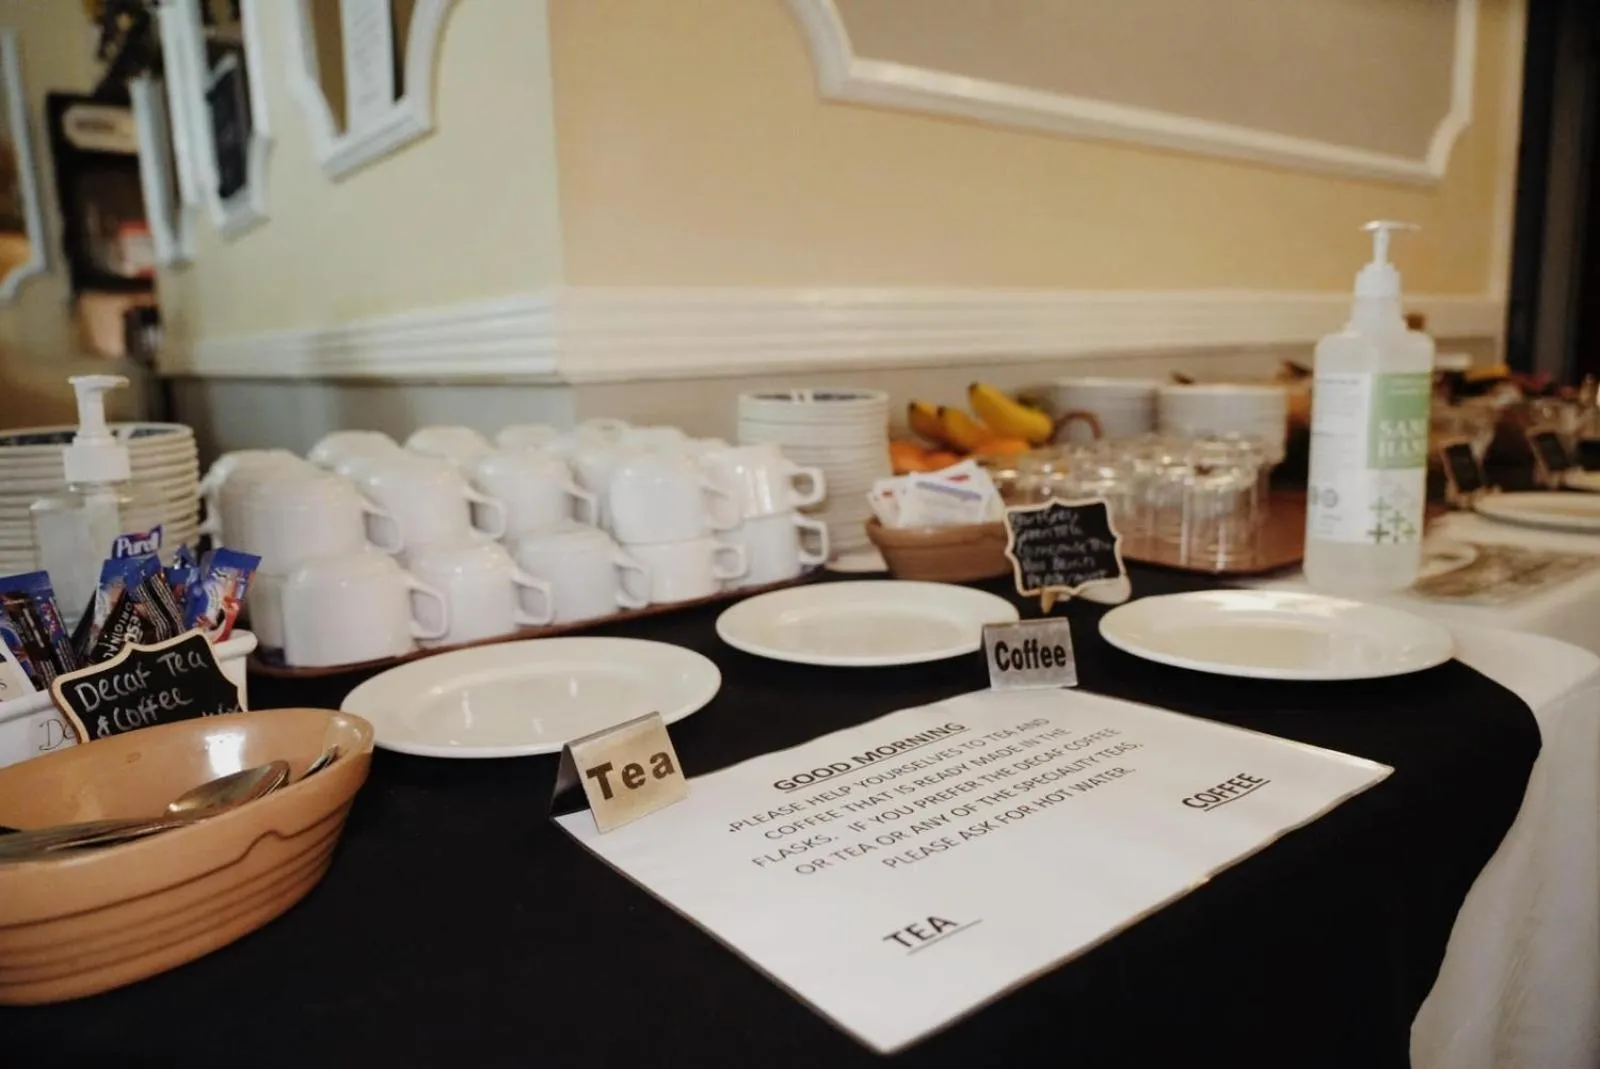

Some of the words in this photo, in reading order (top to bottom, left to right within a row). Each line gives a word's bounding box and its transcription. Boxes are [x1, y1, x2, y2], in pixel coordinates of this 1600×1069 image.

[74, 663, 151, 712] Decaf
[156, 650, 208, 678] Tea
[994, 639, 1066, 671] Coffee
[113, 686, 194, 732] Coffee
[585, 751, 676, 801] Tea
[764, 809, 844, 840] COFFEE
[840, 791, 894, 813] THAT
[893, 784, 916, 796] IS
[915, 763, 972, 788] READY
[969, 745, 1023, 767] MADE
[1019, 738, 1041, 749] IN
[1037, 727, 1072, 741] THE
[773, 762, 852, 791] GOOD
[851, 722, 966, 765] MORNING
[807, 786, 851, 806] HELP
[854, 747, 963, 788] YOURSELVES
[959, 738, 987, 751] TO
[983, 729, 1017, 742] TEA
[1016, 718, 1050, 732] AND
[752, 833, 839, 867] FLASKS.
[847, 820, 868, 833] IF
[868, 805, 914, 824] YOU
[913, 780, 984, 809] PREFER
[977, 767, 1018, 784] THE
[1012, 748, 1064, 771] DECAF
[1063, 728, 1121, 752] COFFEE
[795, 857, 830, 875] OR
[829, 843, 878, 862] TEA
[875, 831, 911, 846] OR
[909, 814, 952, 835] ANY
[950, 803, 979, 818] OF
[975, 788, 1020, 806] THE
[1013, 755, 1101, 793] SPECIALITY
[881, 836, 961, 868] PLEASE
[957, 820, 1000, 840] ASK
[994, 804, 1039, 825] FOR
[1032, 789, 1074, 808] HOT
[1068, 767, 1136, 793] WATER.
[1182, 772, 1264, 808] COFFEE
[882, 916, 958, 947] TEA
